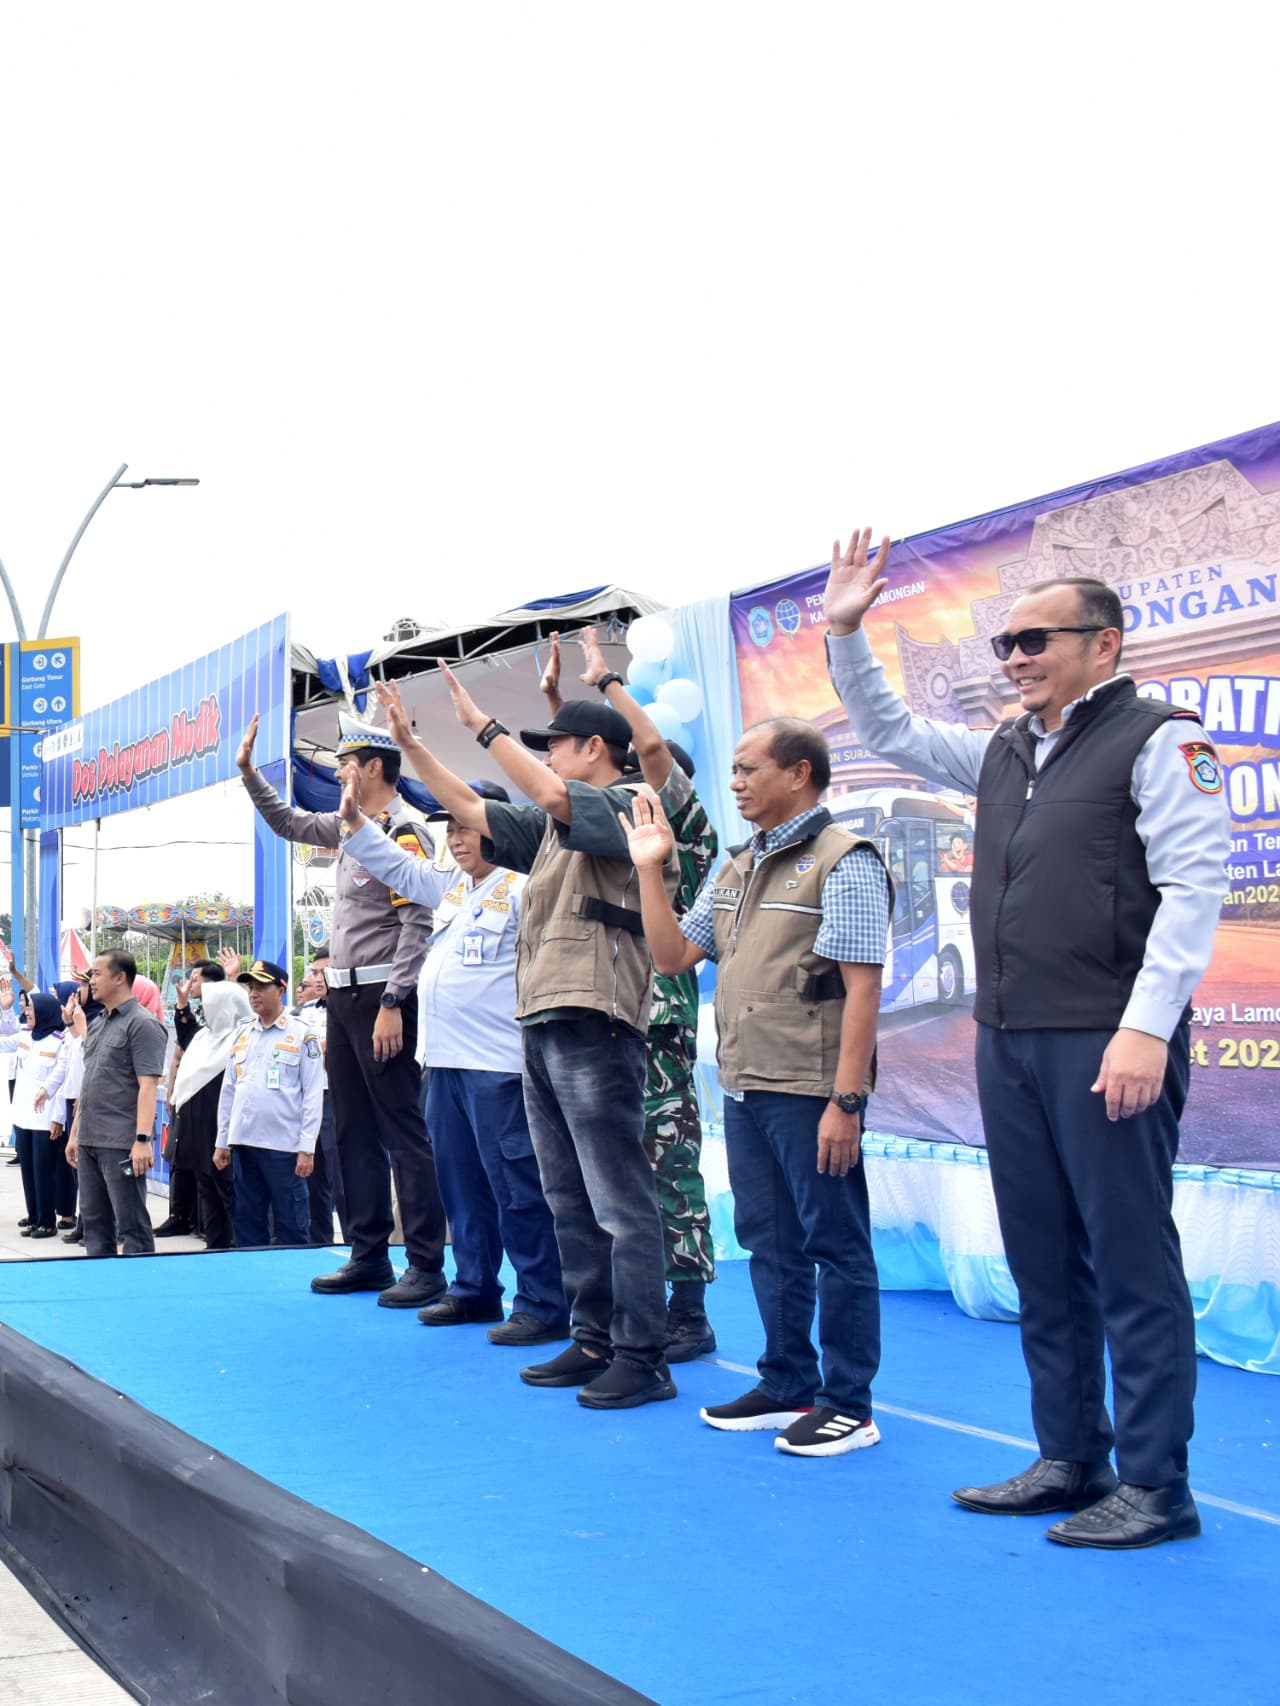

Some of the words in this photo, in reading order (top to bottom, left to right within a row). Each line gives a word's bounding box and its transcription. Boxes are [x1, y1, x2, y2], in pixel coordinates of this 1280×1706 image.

[170, 694, 222, 768] Mudik
[843, 748, 878, 762] SURA
[1222, 762, 1280, 816] ON
